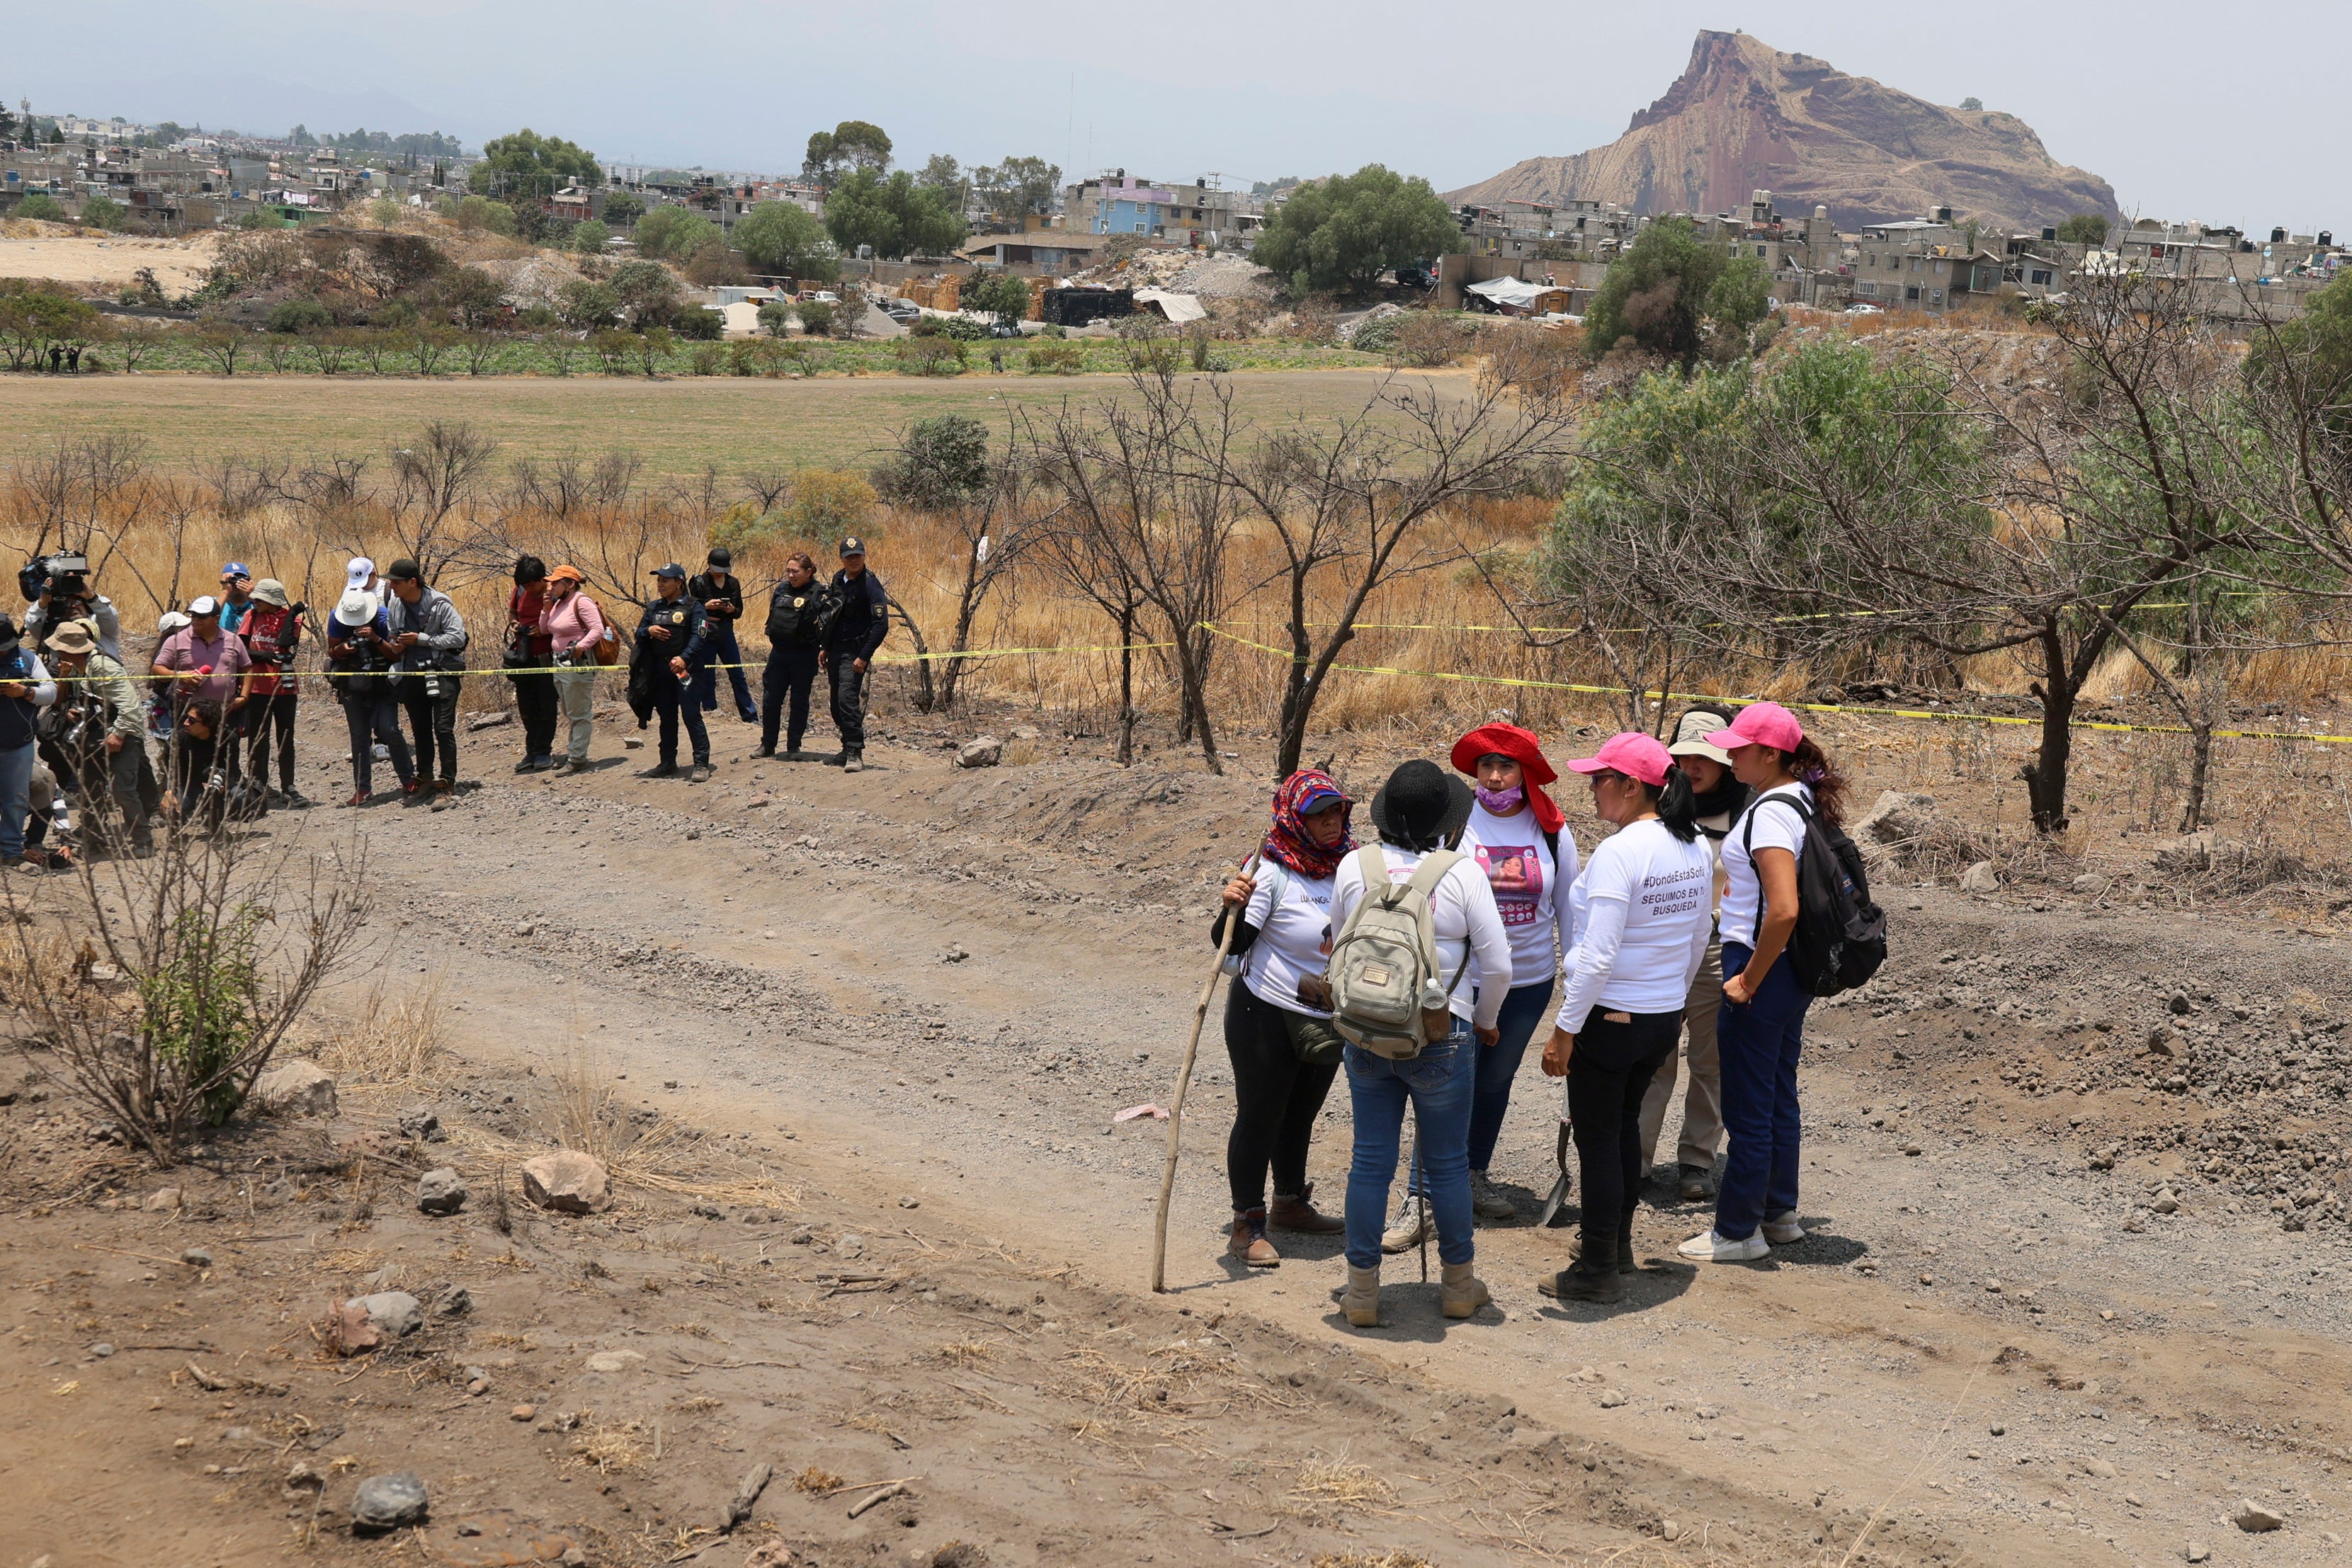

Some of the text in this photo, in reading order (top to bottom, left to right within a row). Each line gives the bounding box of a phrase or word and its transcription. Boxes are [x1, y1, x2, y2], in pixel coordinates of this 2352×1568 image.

[1641, 890, 1686, 905] SEGUIMOS
[1688, 887, 1699, 897] EN
[1652, 900, 1697, 916] BUSQUEDA
